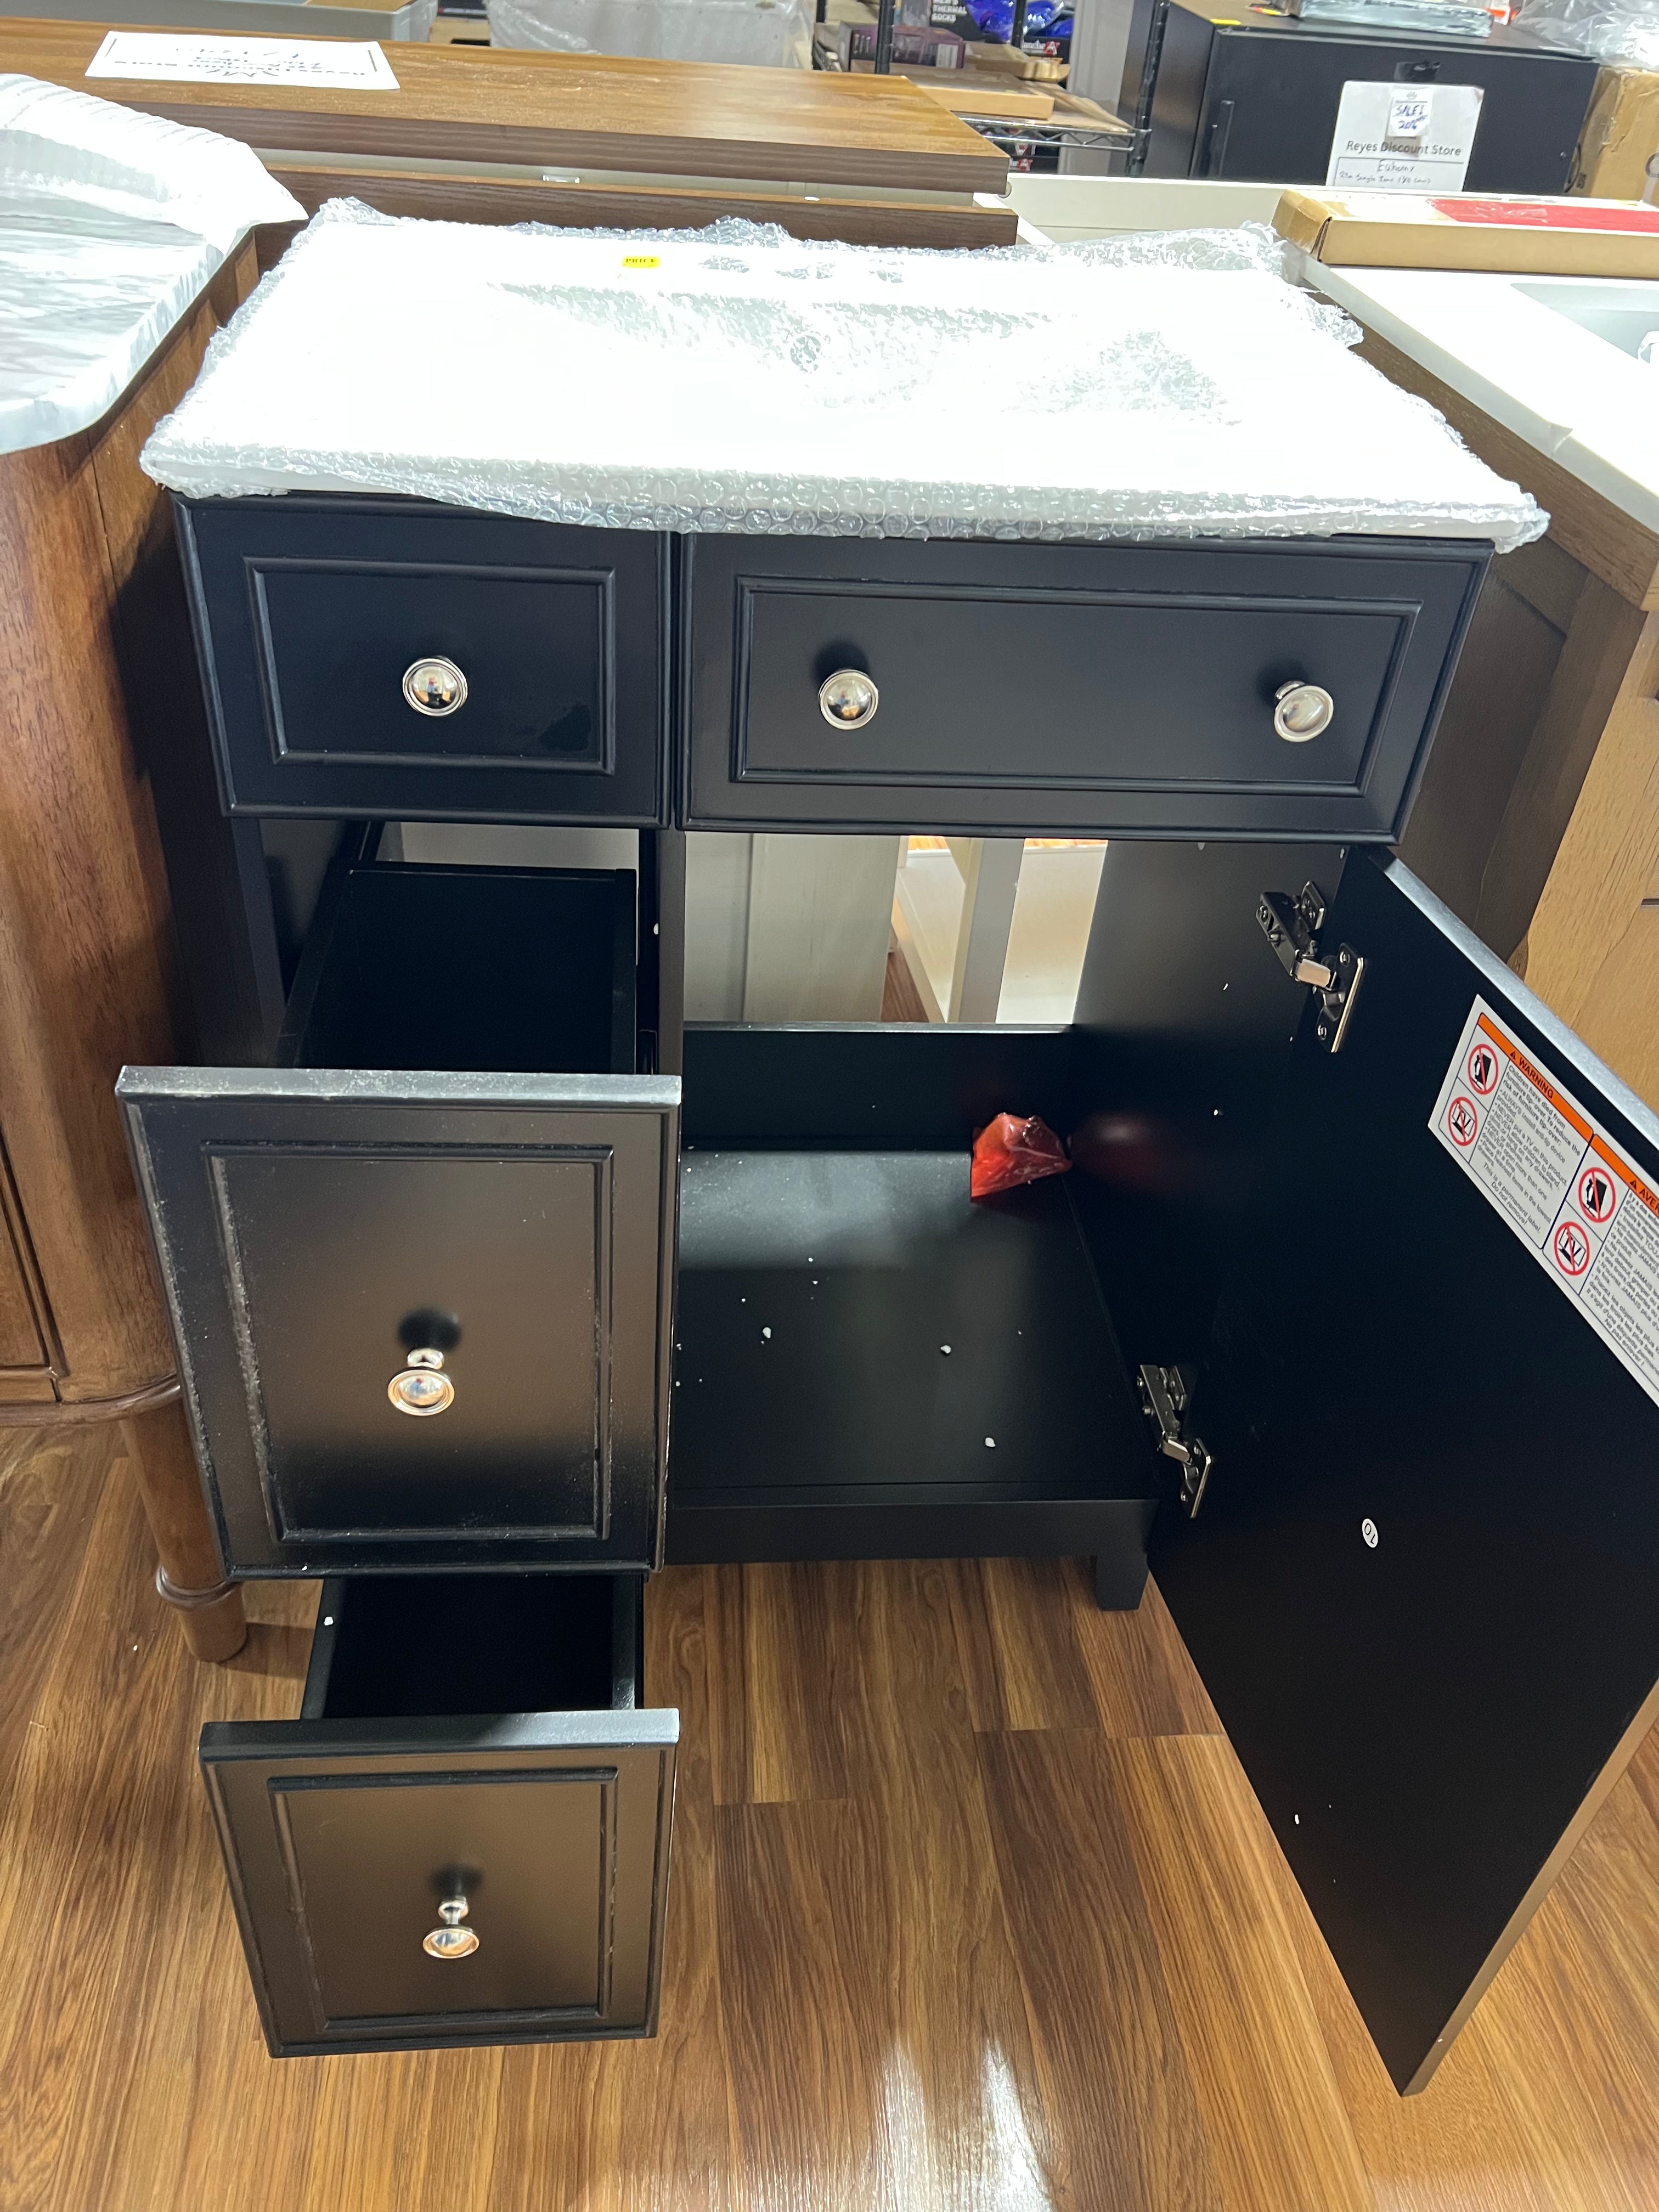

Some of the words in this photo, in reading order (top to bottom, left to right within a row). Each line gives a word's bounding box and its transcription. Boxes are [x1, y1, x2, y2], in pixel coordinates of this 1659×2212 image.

[1346, 140, 1378, 154] Reyes
[1380, 142, 1428, 154] Discount
[1430, 145, 1462, 156] Store
[1519, 1057, 1554, 1099] WARNING
[1528, 1086, 1541, 1103] have
[1541, 1102, 1554, 1116] died
[1553, 1113, 1565, 1130] from
[1526, 1136, 1534, 1146] TV
[1533, 1146, 1540, 1155] on
[1539, 1152, 1549, 1165] this
[1547, 1115, 1553, 1126] To
[1553, 1125, 1571, 1146] reduce
[1571, 1144, 1581, 1156] the
